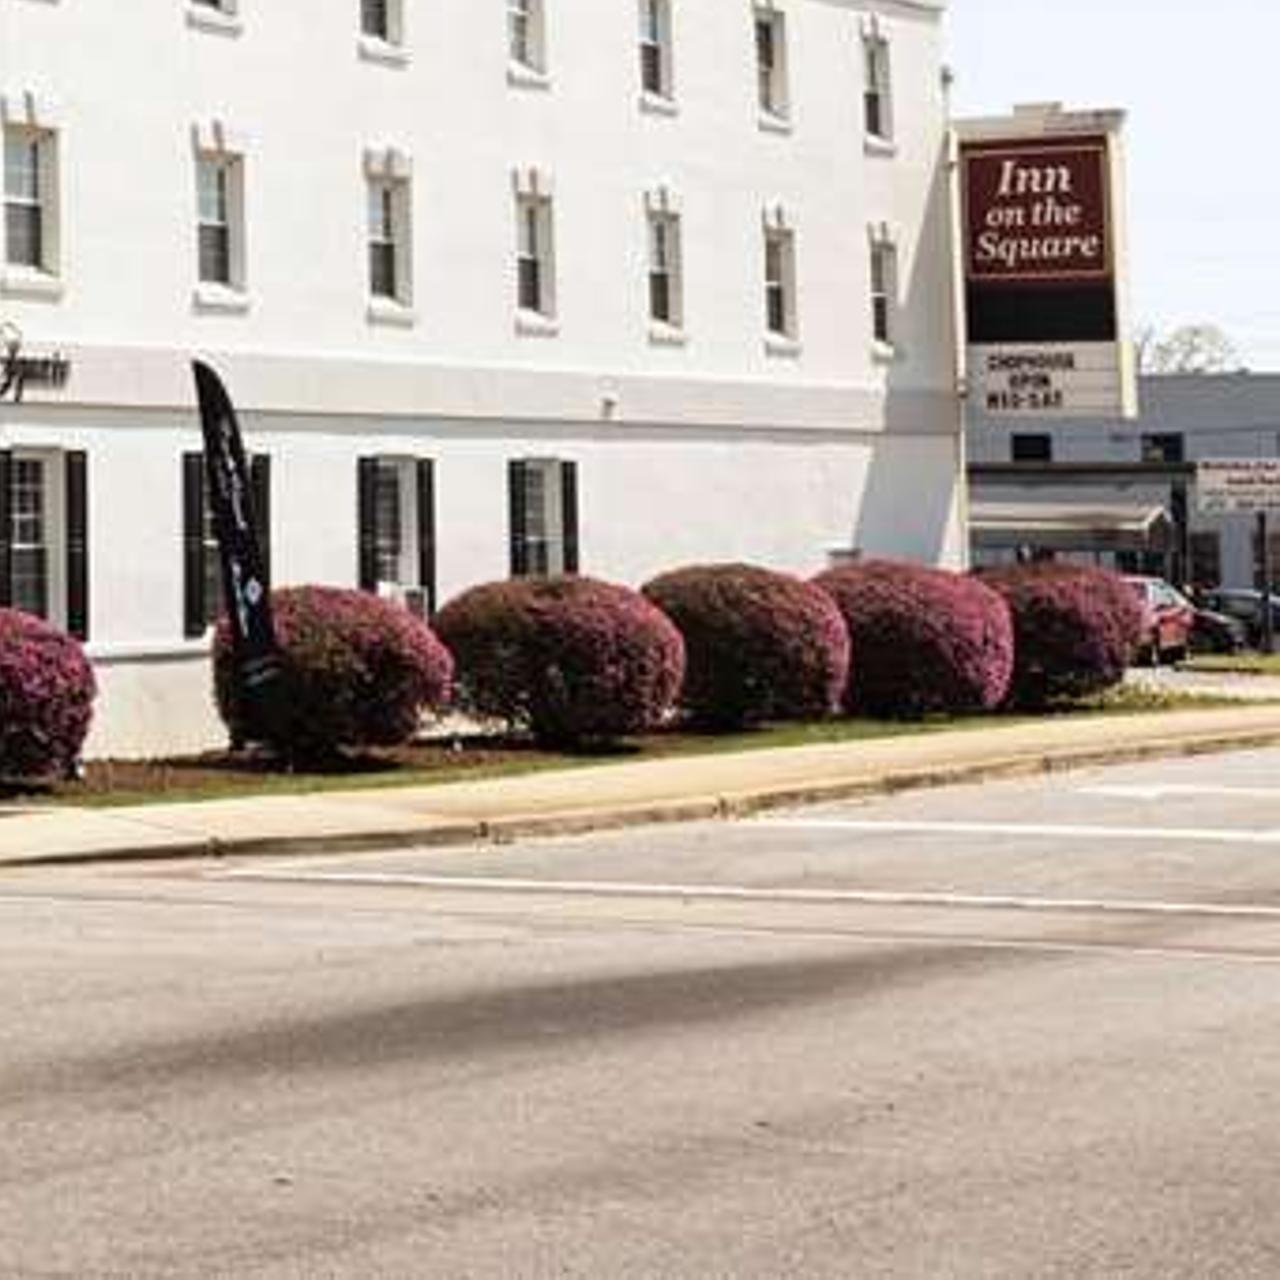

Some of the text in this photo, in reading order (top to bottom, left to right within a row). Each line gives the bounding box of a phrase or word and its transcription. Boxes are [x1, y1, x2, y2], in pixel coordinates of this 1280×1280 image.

[997, 160, 1071, 195] Inn
[986, 197, 1082, 228] on the
[976, 231, 1099, 268] Square
